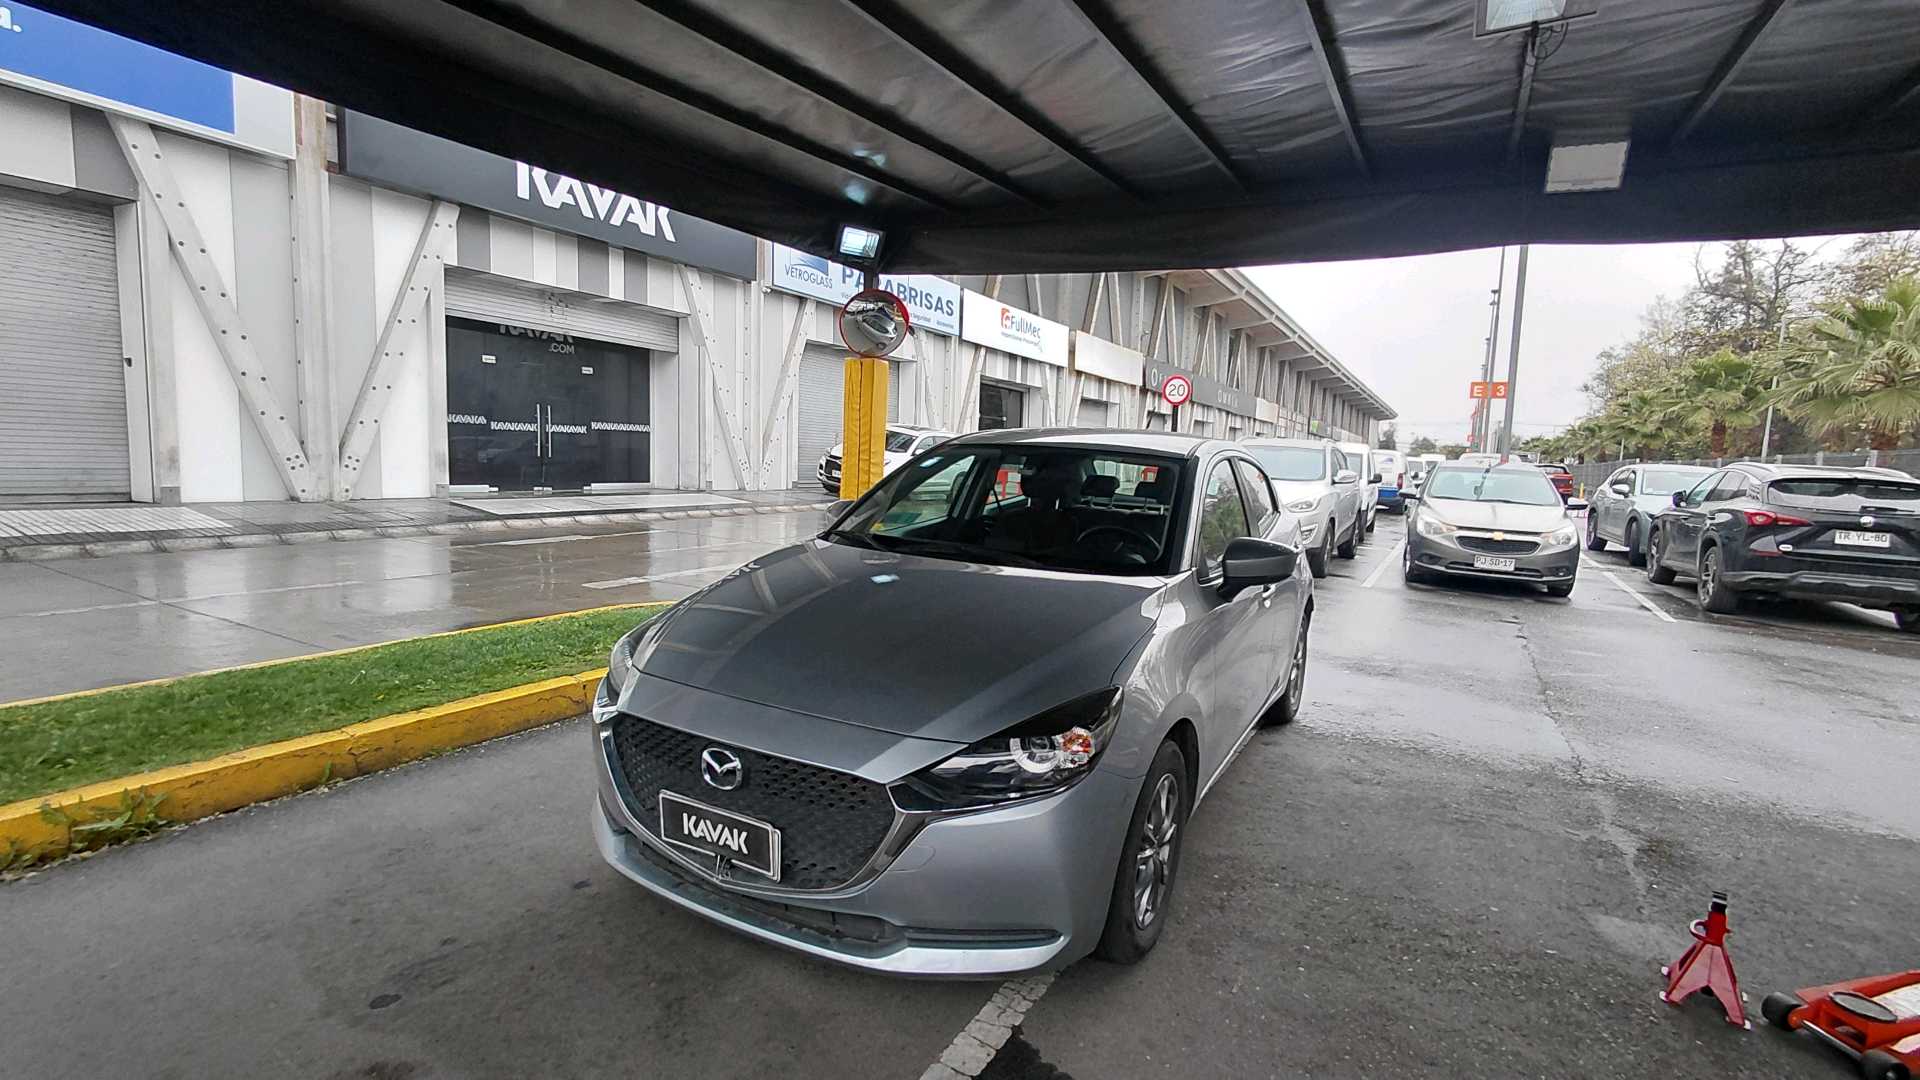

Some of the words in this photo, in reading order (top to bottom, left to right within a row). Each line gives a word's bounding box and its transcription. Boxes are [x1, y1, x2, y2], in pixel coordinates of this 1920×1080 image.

[516, 161, 676, 243] KAVAK
[784, 263, 833, 289] VETROGLASS
[1168, 383, 1186, 397] 20
[1473, 385, 1485, 397] E
[1496, 384, 1505, 397] 3
[682, 812, 749, 855] KAVAK
